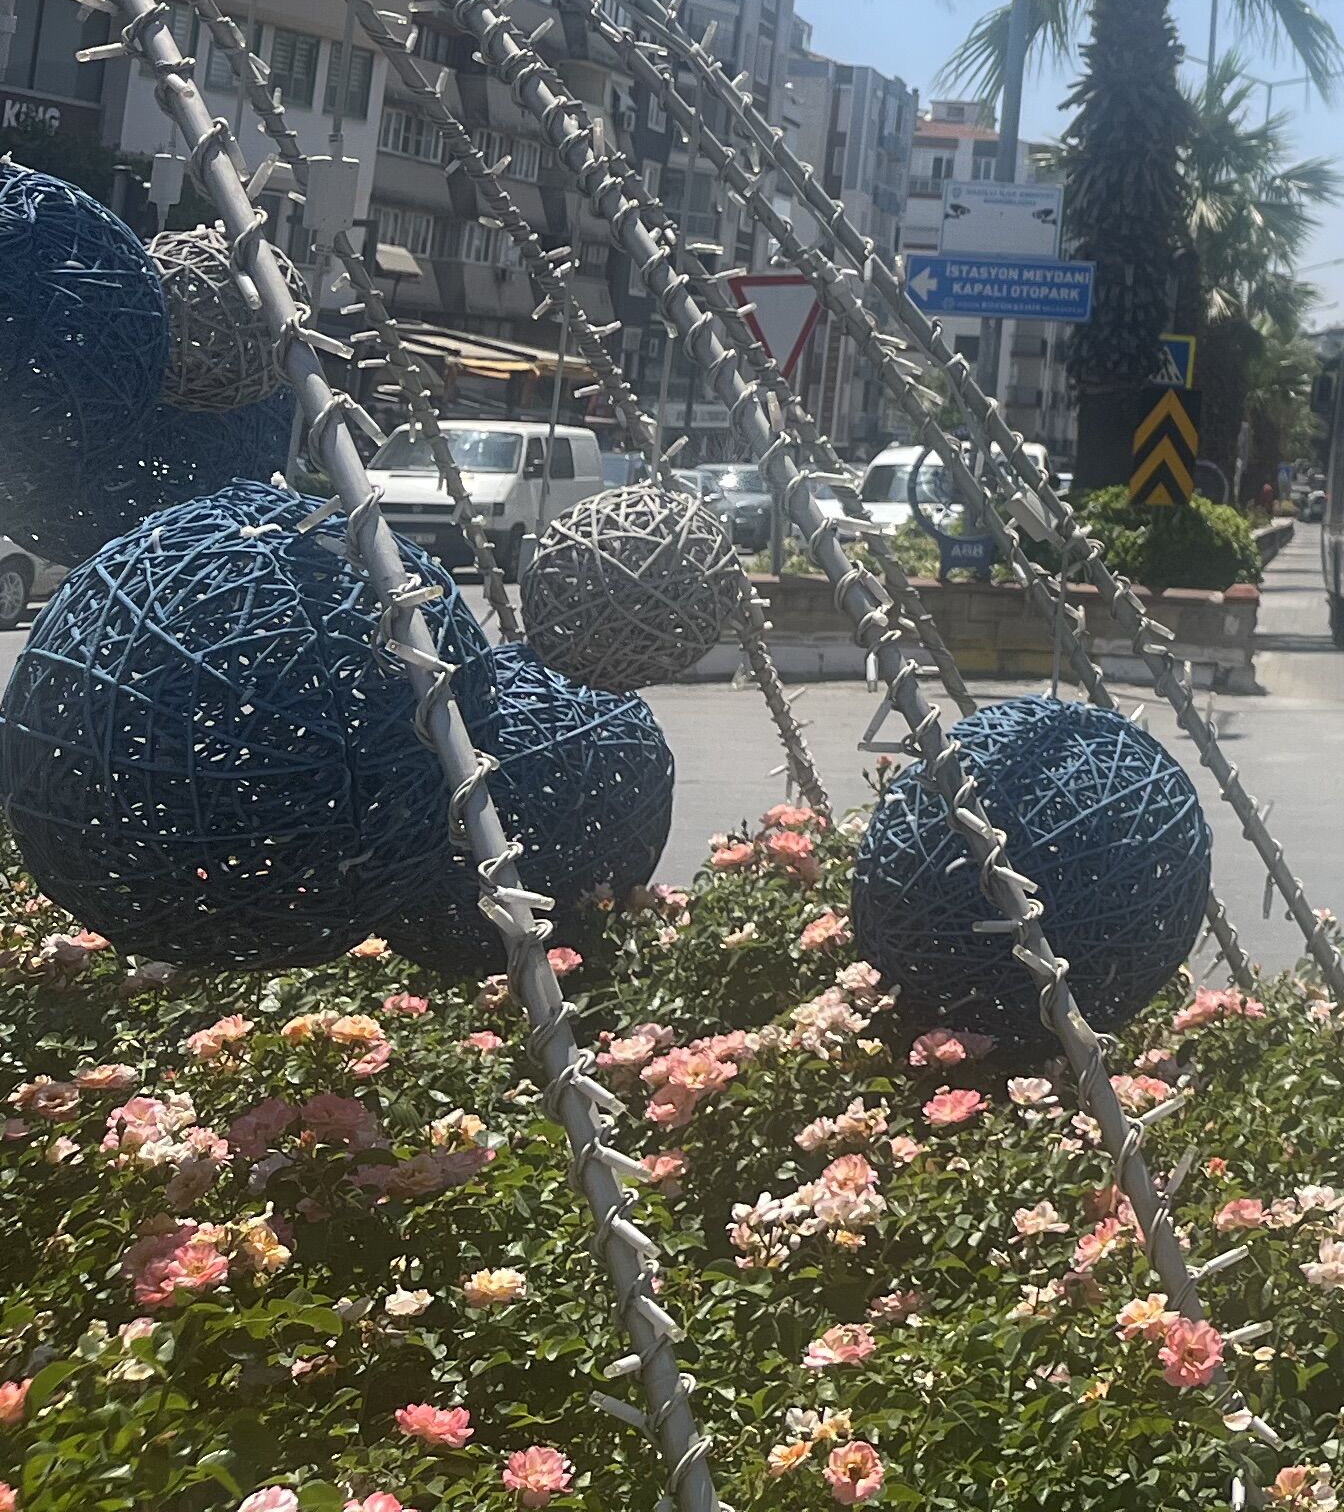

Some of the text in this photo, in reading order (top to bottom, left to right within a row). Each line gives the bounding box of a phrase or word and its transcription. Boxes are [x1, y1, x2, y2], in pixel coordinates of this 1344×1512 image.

[946, 262, 1089, 284] İSTASYON MEYDANI
[952, 281, 1081, 302] KAPALI OTOPARK
